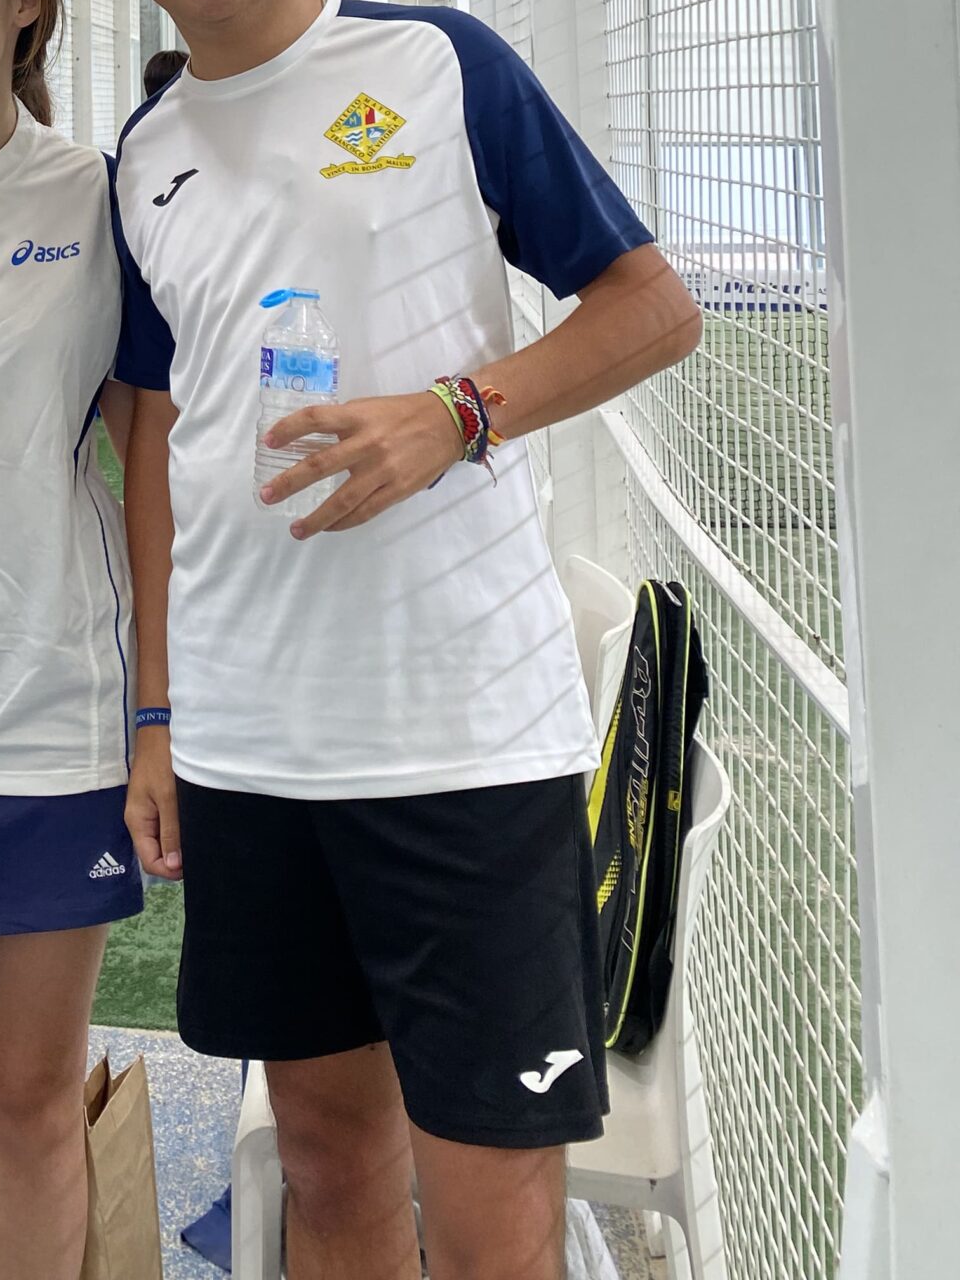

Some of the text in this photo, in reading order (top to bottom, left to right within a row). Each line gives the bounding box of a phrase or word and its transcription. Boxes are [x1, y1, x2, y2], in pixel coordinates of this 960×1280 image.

[330, 135, 365, 158] FRANCISCO
[375, 123, 400, 148] VITORIA
[88, 863, 126, 879] adidas
